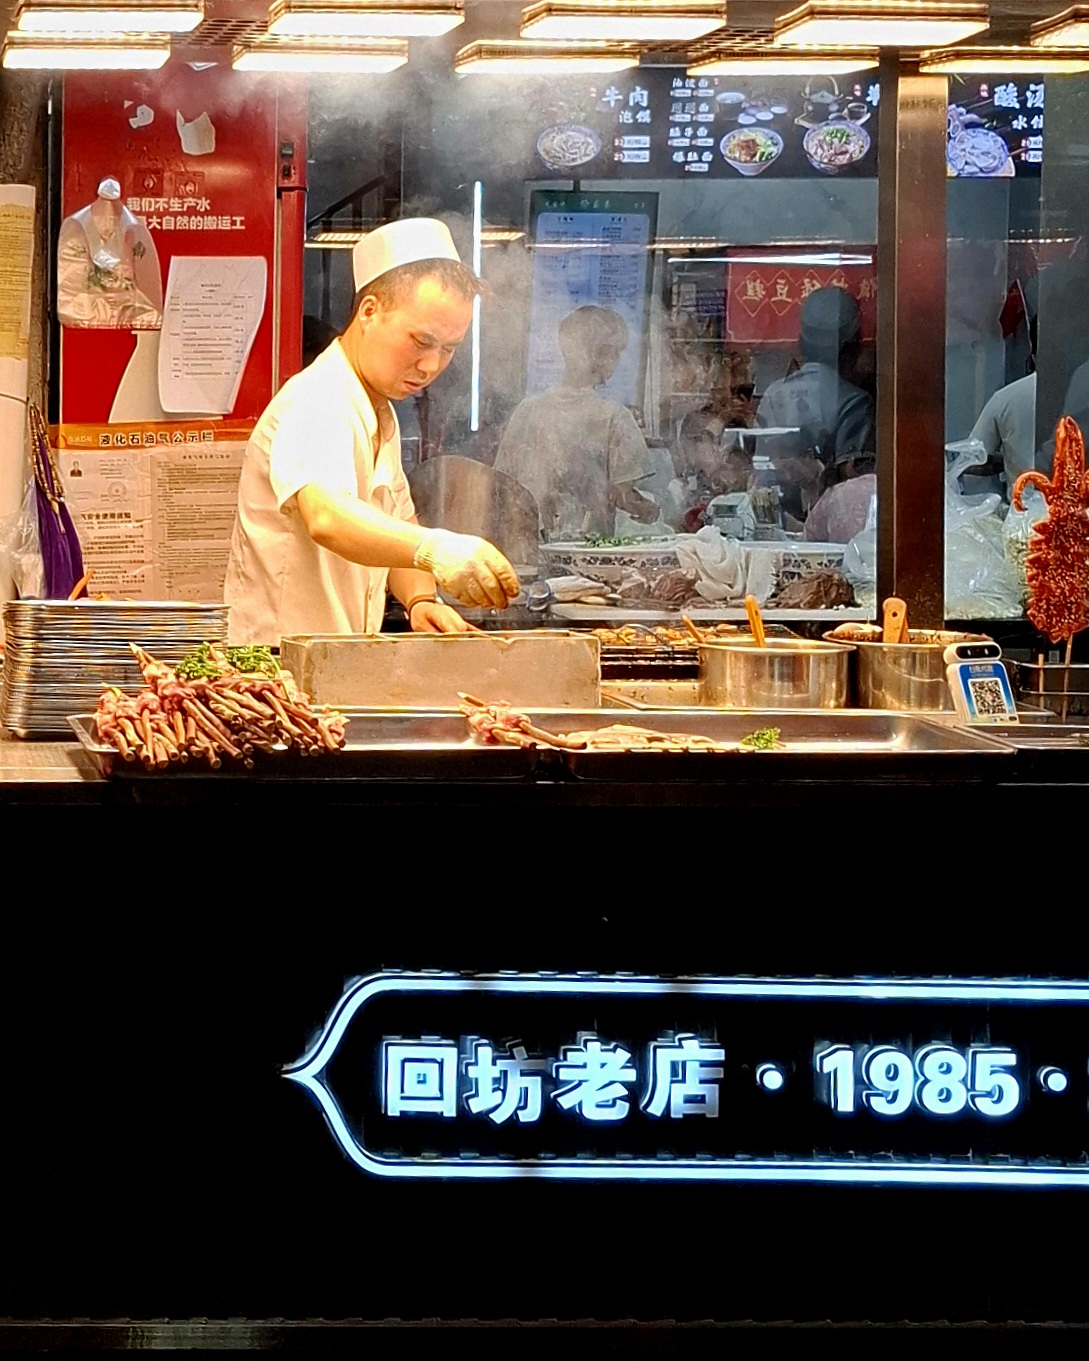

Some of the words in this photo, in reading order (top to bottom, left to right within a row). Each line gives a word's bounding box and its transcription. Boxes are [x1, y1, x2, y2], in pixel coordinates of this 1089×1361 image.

[127, 197, 210, 212] 我们不生产水
[383, 1034, 726, 1125] 回坊老店
[819, 1043, 1021, 1116] 1985
